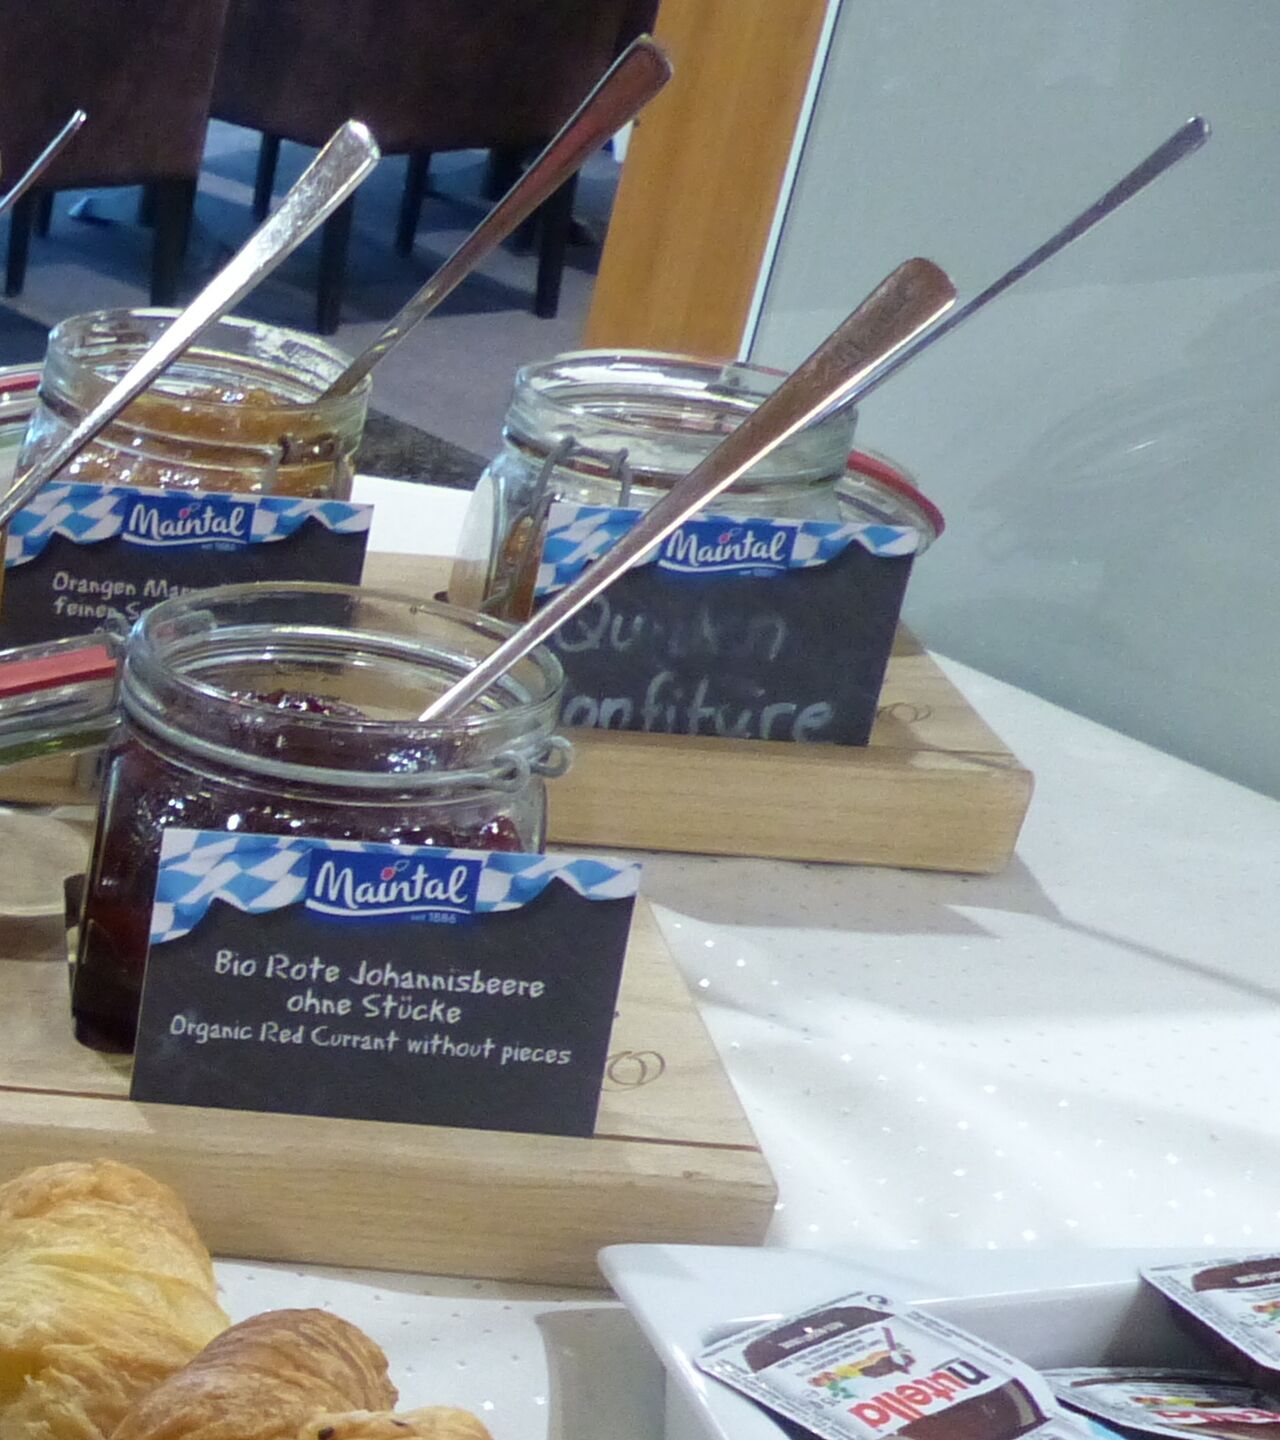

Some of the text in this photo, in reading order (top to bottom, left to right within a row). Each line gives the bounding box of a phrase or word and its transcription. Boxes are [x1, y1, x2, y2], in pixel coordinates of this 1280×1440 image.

[128, 504, 246, 540] Maintal
[666, 528, 787, 568] Maintal
[51, 571, 137, 600] Orangen
[313, 859, 470, 909] Maintal
[214, 949, 546, 999] Bio Rote Johannisbeere
[286, 988, 463, 1024] ohne Stücke
[169, 1014, 572, 1066] Organic Red Currant without pieces
[847, 1360, 991, 1429] nutella
